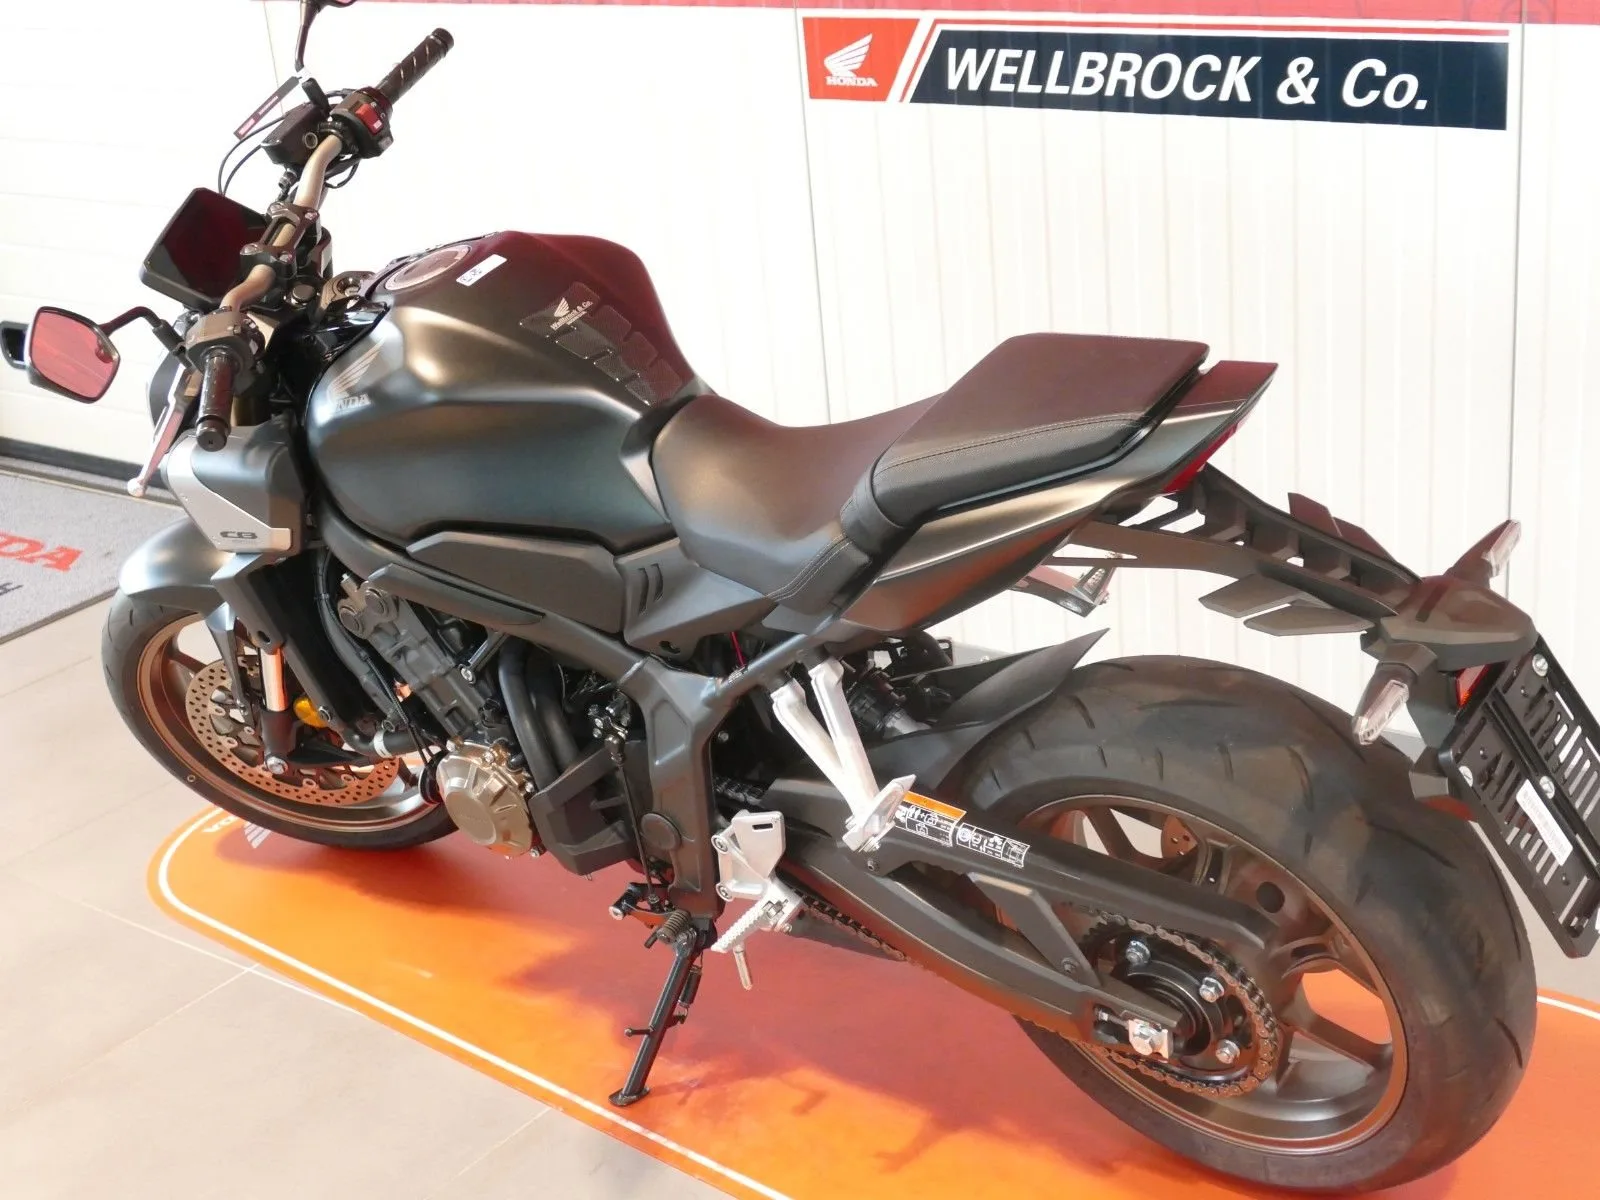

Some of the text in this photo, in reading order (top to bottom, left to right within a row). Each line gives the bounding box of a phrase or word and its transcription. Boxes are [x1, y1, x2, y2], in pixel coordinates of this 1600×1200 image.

[825, 76, 879, 87] HONDA
[947, 47, 1428, 110] WELLBROCK & Co.
[220, 530, 258, 540] CB
